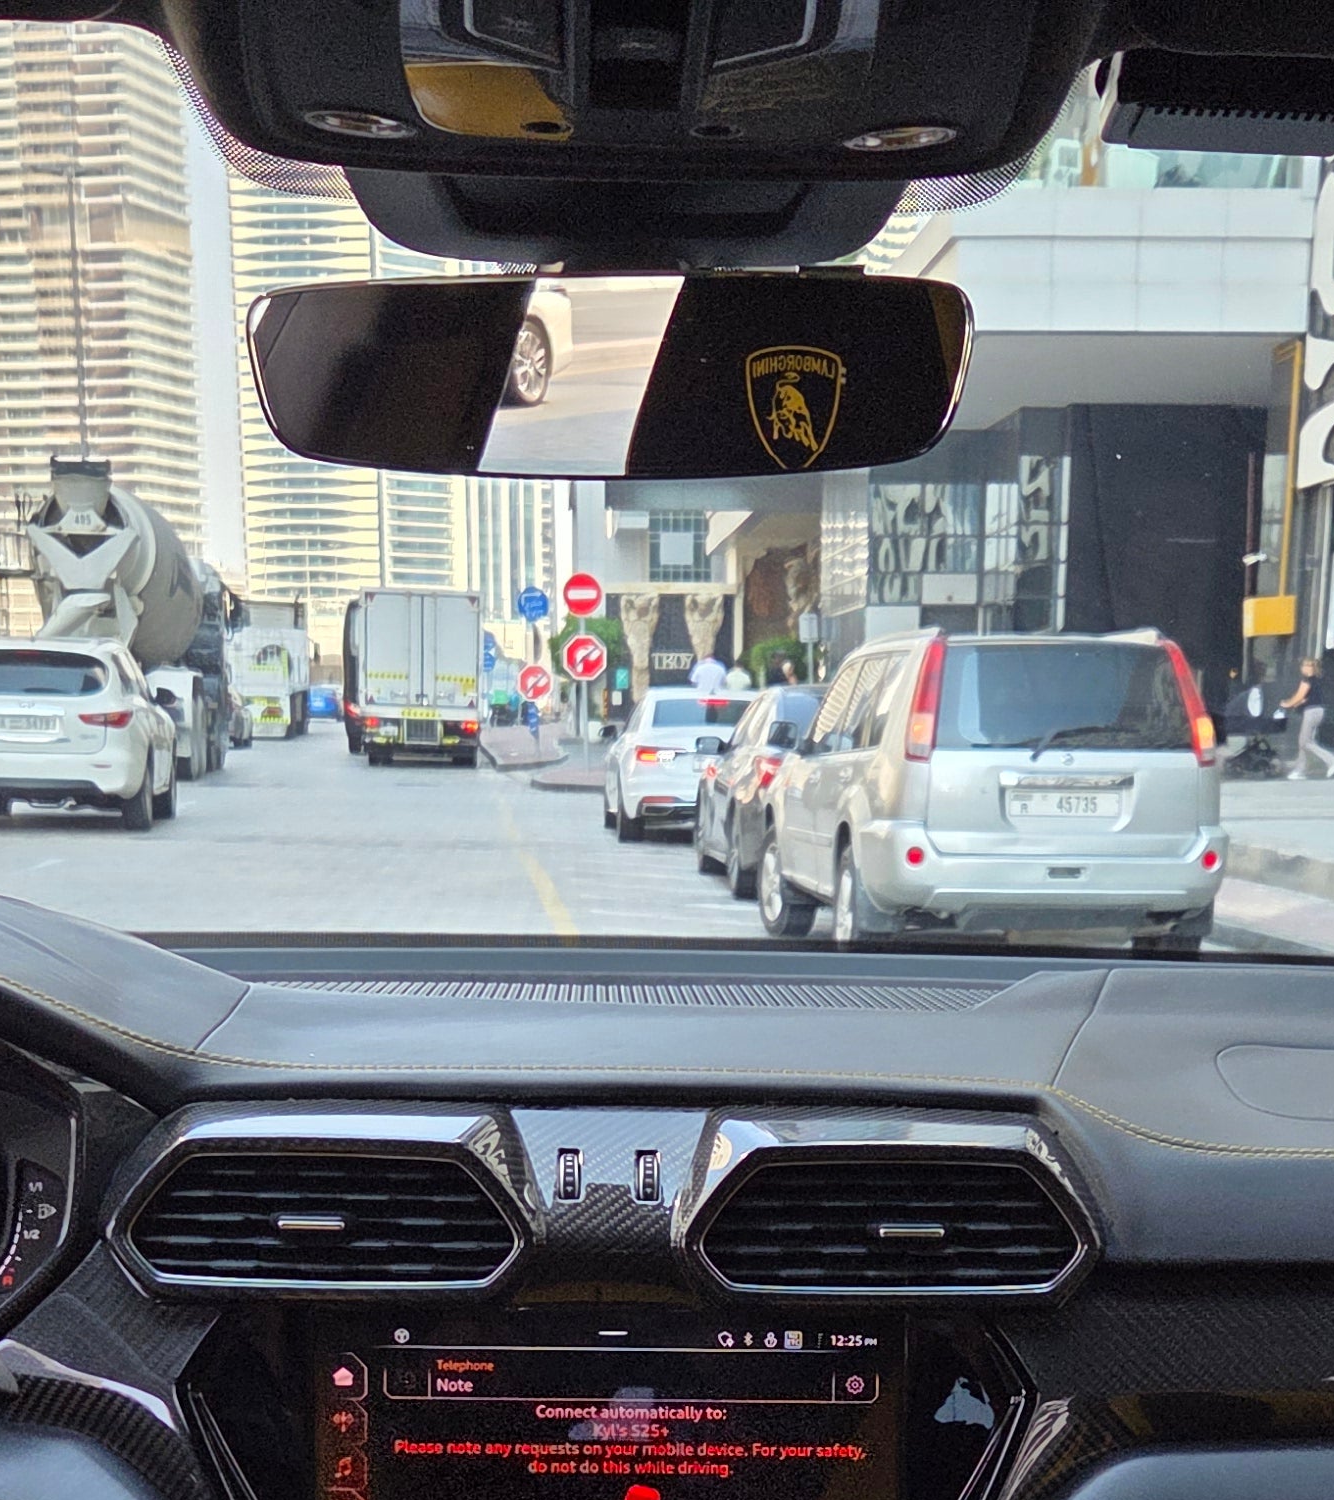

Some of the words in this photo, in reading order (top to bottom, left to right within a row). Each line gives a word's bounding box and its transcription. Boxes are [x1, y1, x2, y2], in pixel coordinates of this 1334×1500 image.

[651, 652, 694, 670] TROY
[1056, 796, 1098, 814] 45735
[830, 1334, 863, 1347] 12:25
[436, 1358, 495, 1374] Telephone
[436, 1377, 474, 1393] Note
[535, 1404, 597, 1421] Connect
[600, 1404, 702, 1424] automatically
[704, 1405, 727, 1421] to:
[593, 1423, 628, 1441] Kyl's
[631, 1424, 670, 1439] S25+
[394, 1439, 443, 1455] Please
[446, 1441, 481, 1455] note
[485, 1444, 512, 1459] any
[515, 1441, 579, 1459] requests
[583, 1445, 603, 1456] on
[605, 1445, 640, 1459] your
[642, 1441, 694, 1457] mobile
[697, 1442, 748, 1458] device.
[752, 1443, 776, 1458] For
[779, 1446, 814, 1461] your
[816, 1442, 867, 1461] safety,
[528, 1460, 547, 1474] do
[551, 1460, 576, 1474] not
[579, 1460, 599, 1474] do
[603, 1460, 631, 1474] this
[634, 1460, 675, 1475] while
[678, 1461, 734, 1477] driving.
